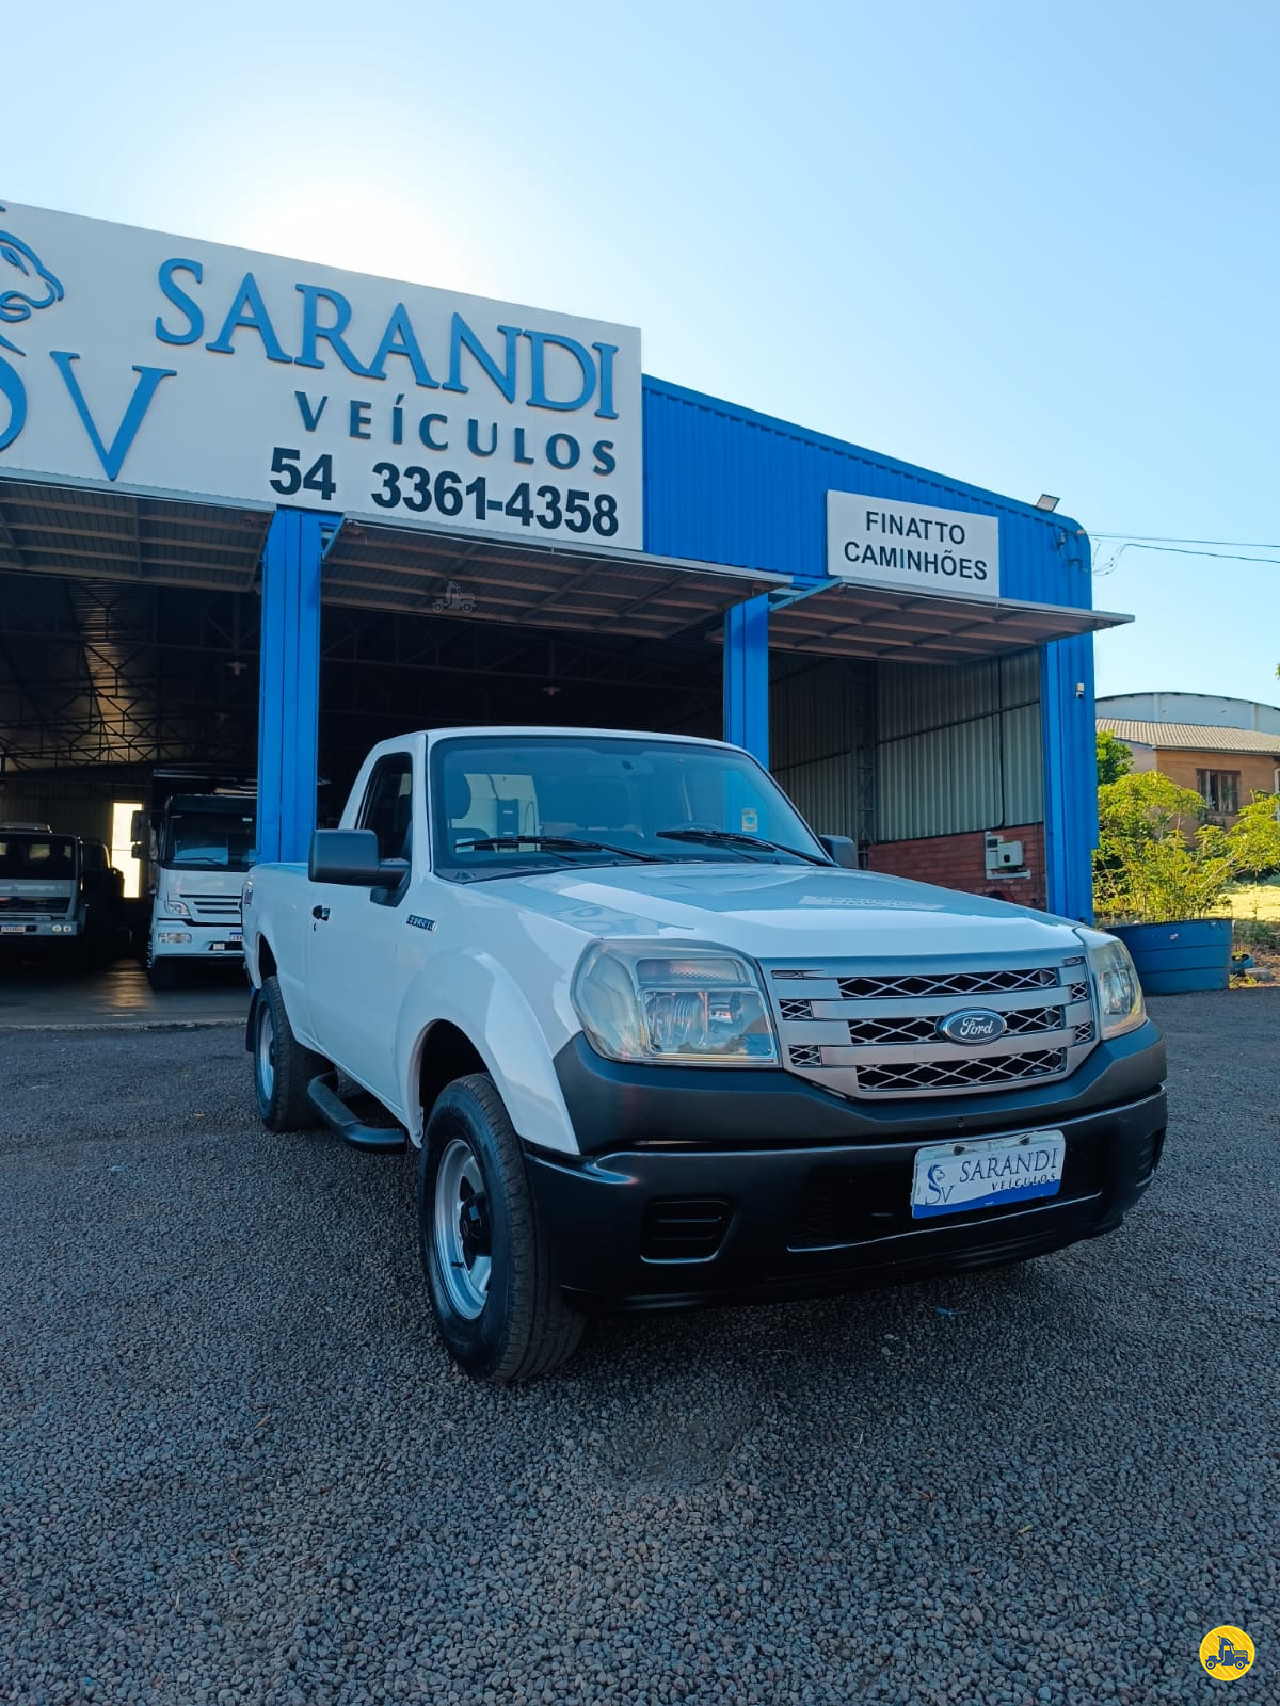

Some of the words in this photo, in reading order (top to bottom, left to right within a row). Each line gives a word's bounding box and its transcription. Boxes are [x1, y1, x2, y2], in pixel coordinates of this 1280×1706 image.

[155, 258, 620, 420] SARANDI
[294, 391, 617, 476] VEÍCULOS
[270, 447, 337, 500] 54
[370, 462, 620, 537] 3361-4358
[866, 511, 965, 545] FINATTO
[844, 542, 988, 580] CAMINHÕES
[960, 1016, 994, 1035] Ford
[959, 1147, 1058, 1183] SARANDI
